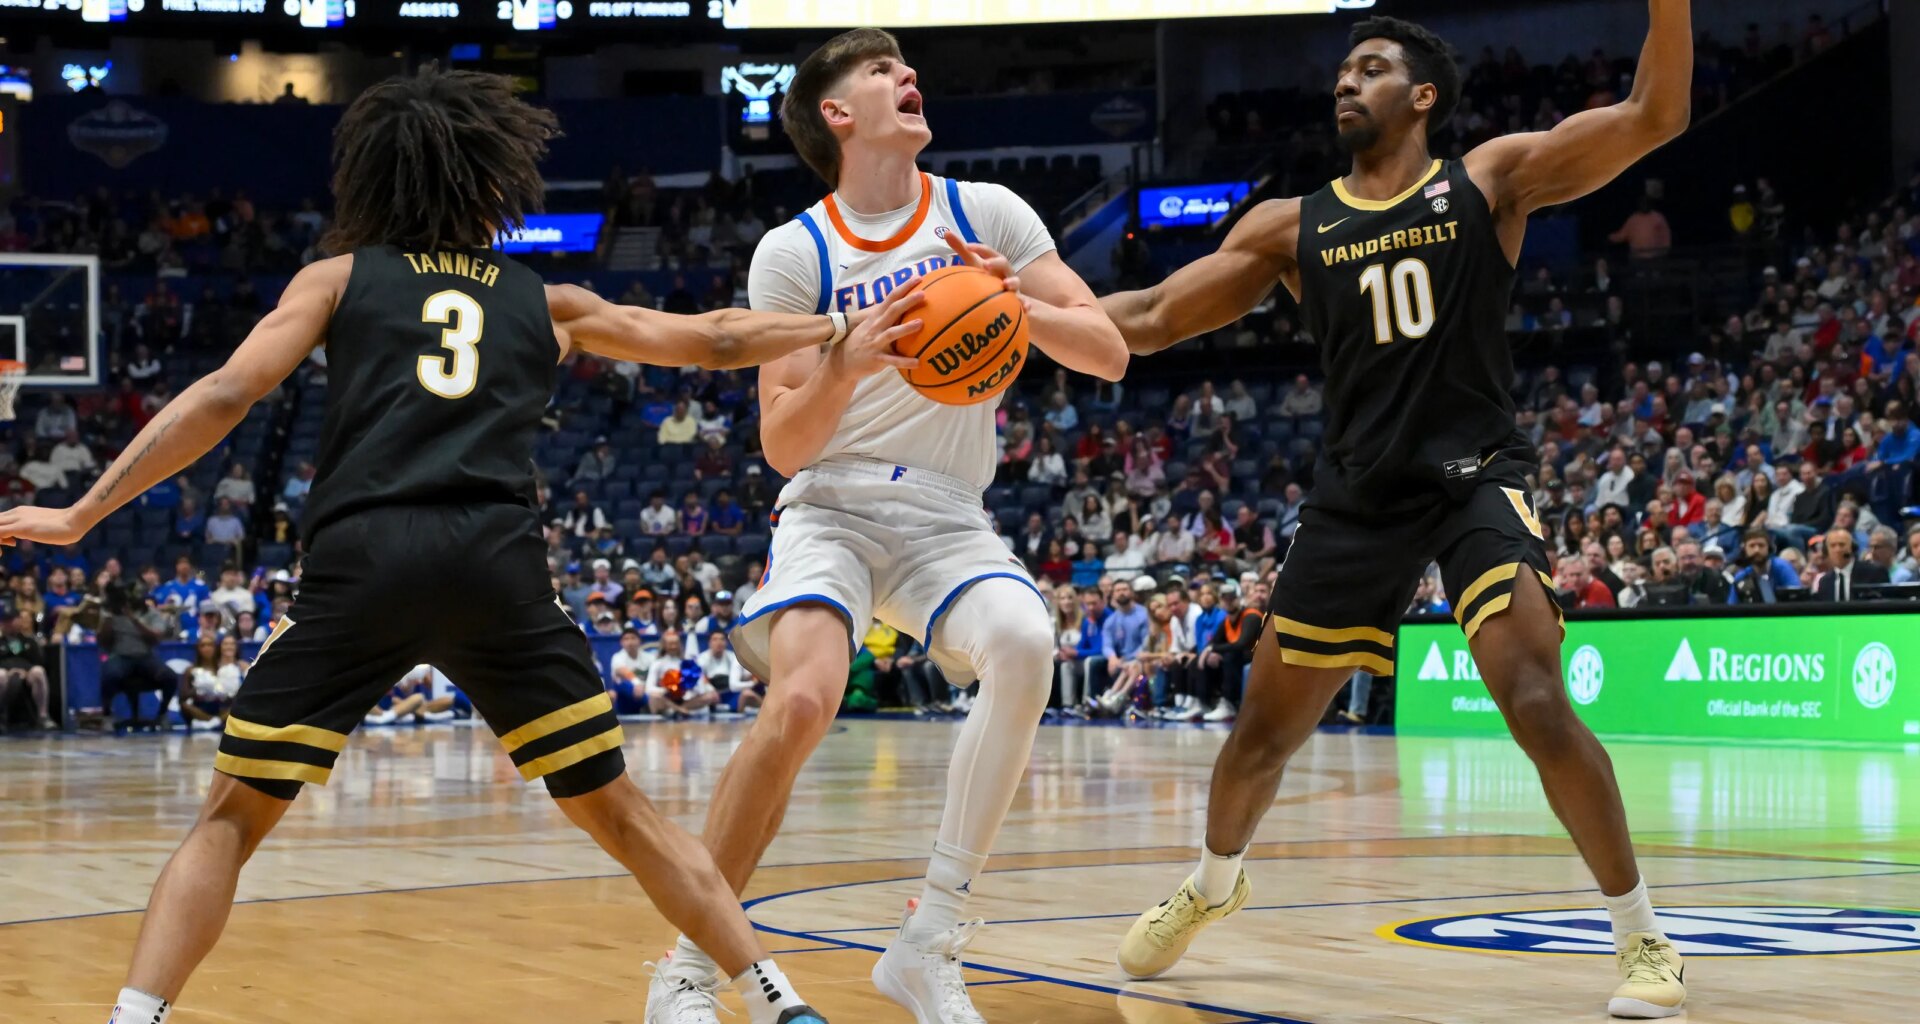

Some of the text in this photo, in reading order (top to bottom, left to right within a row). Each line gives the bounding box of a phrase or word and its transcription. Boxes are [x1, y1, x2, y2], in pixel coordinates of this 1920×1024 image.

[400, 2, 459, 17] ASSISTS
[1433, 198, 1448, 212] SEC
[1320, 220, 1458, 267] VANDERBILT
[403, 251, 500, 287] TANNER
[1358, 257, 1436, 344] 10
[416, 289, 484, 399] 3
[927, 312, 1013, 375] Wilson
[967, 348, 1022, 398] NCAA
[890, 465, 908, 481] F
[1707, 647, 1826, 683] REGIONS
[1855, 645, 1894, 705] SEC
[1452, 695, 1500, 711] Official Ban
[1707, 699, 1822, 718] Official Bank of the SEC
